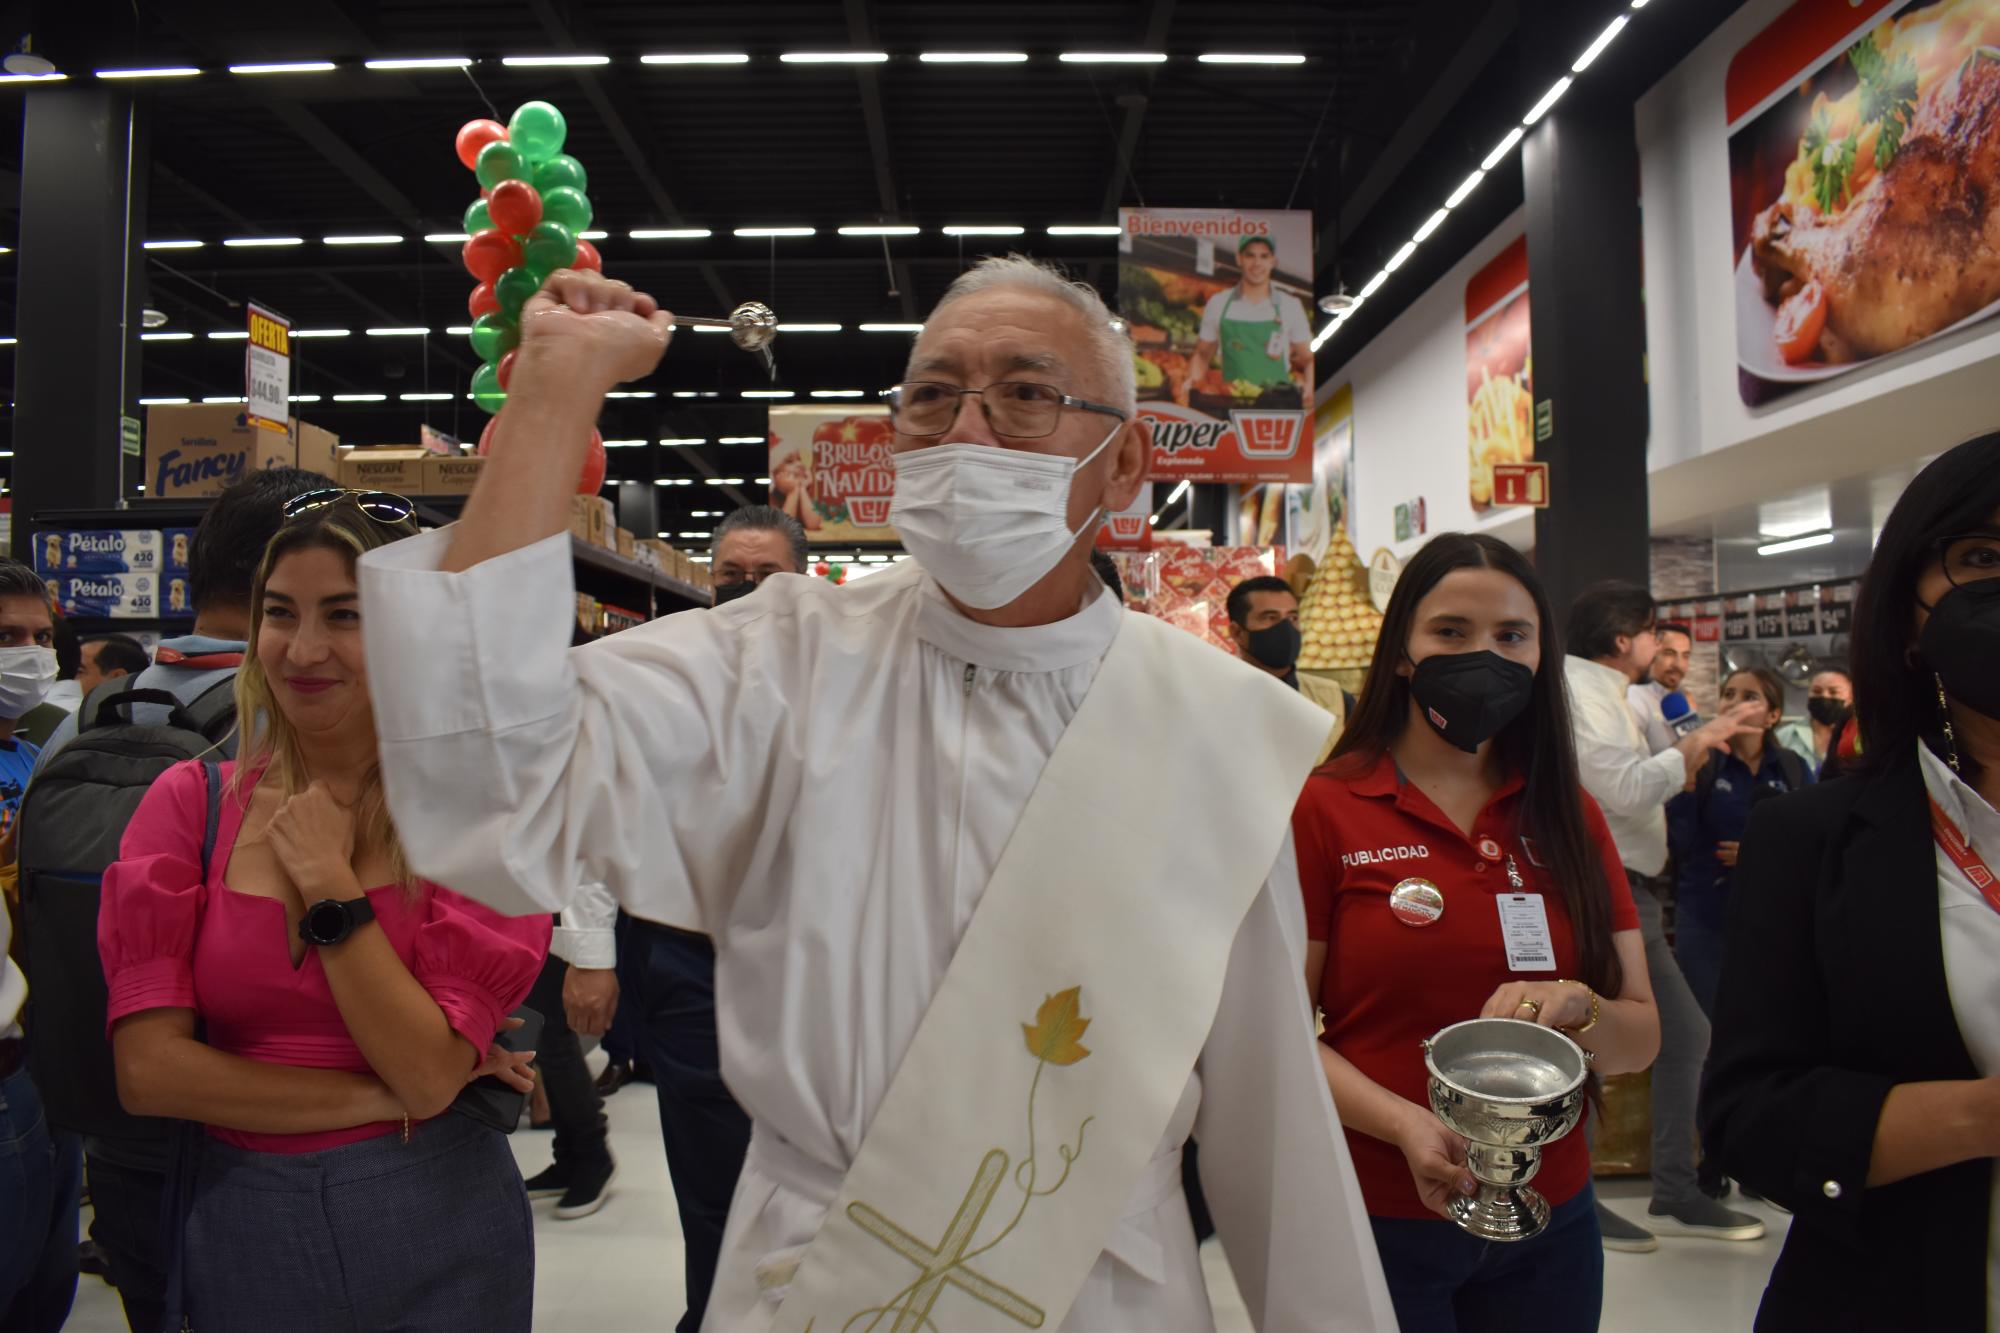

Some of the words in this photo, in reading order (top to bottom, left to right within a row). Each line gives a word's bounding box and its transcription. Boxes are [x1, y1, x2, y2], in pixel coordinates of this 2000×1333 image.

[1127, 214, 1269, 236] Bienvenidos
[251, 313, 288, 355] OFERTA
[156, 449, 246, 497] Fancy
[816, 464, 892, 498] NAVID
[69, 532, 125, 553] Pétalo
[133, 552, 153, 562] 420
[70, 578, 123, 598] Pétalo
[131, 598, 151, 607] 420
[1342, 845, 1429, 869] PUBLICIDAD
